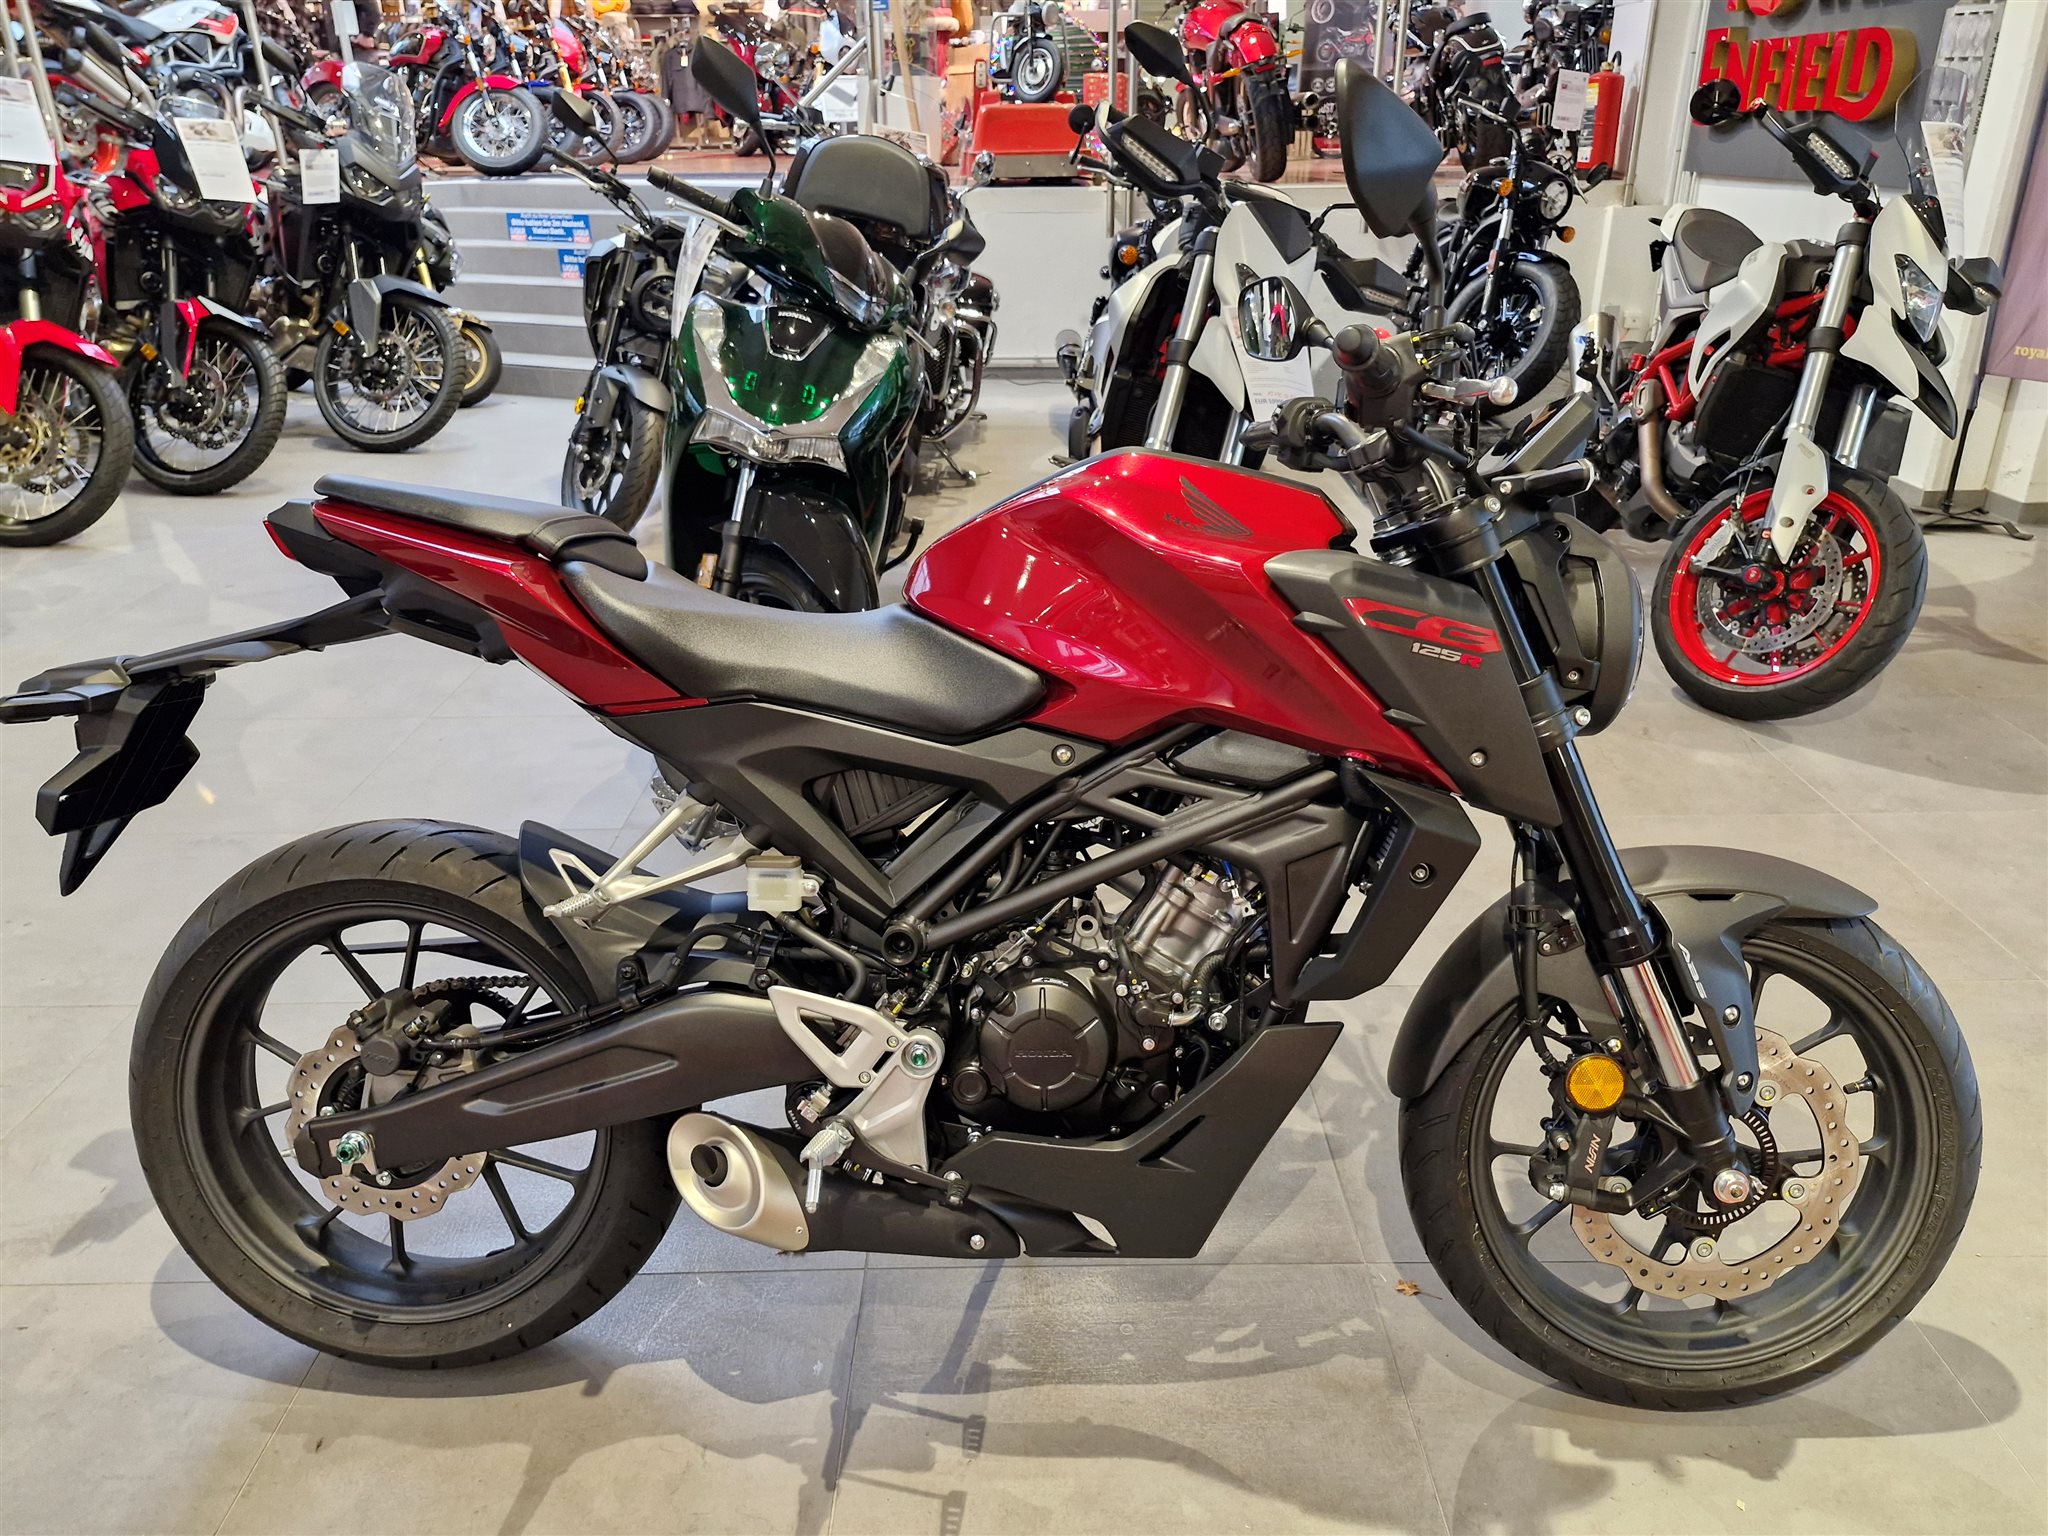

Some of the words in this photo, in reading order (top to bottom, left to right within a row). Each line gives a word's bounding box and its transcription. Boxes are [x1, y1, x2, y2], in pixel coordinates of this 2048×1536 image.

[1691, 26, 1897, 125] ENFIELD
[778, 311, 813, 324] HONDA
[1412, 642, 1484, 669] 125R
[1014, 1049, 1073, 1059] HONDA
[1584, 1133, 1601, 1174] NISSIN
